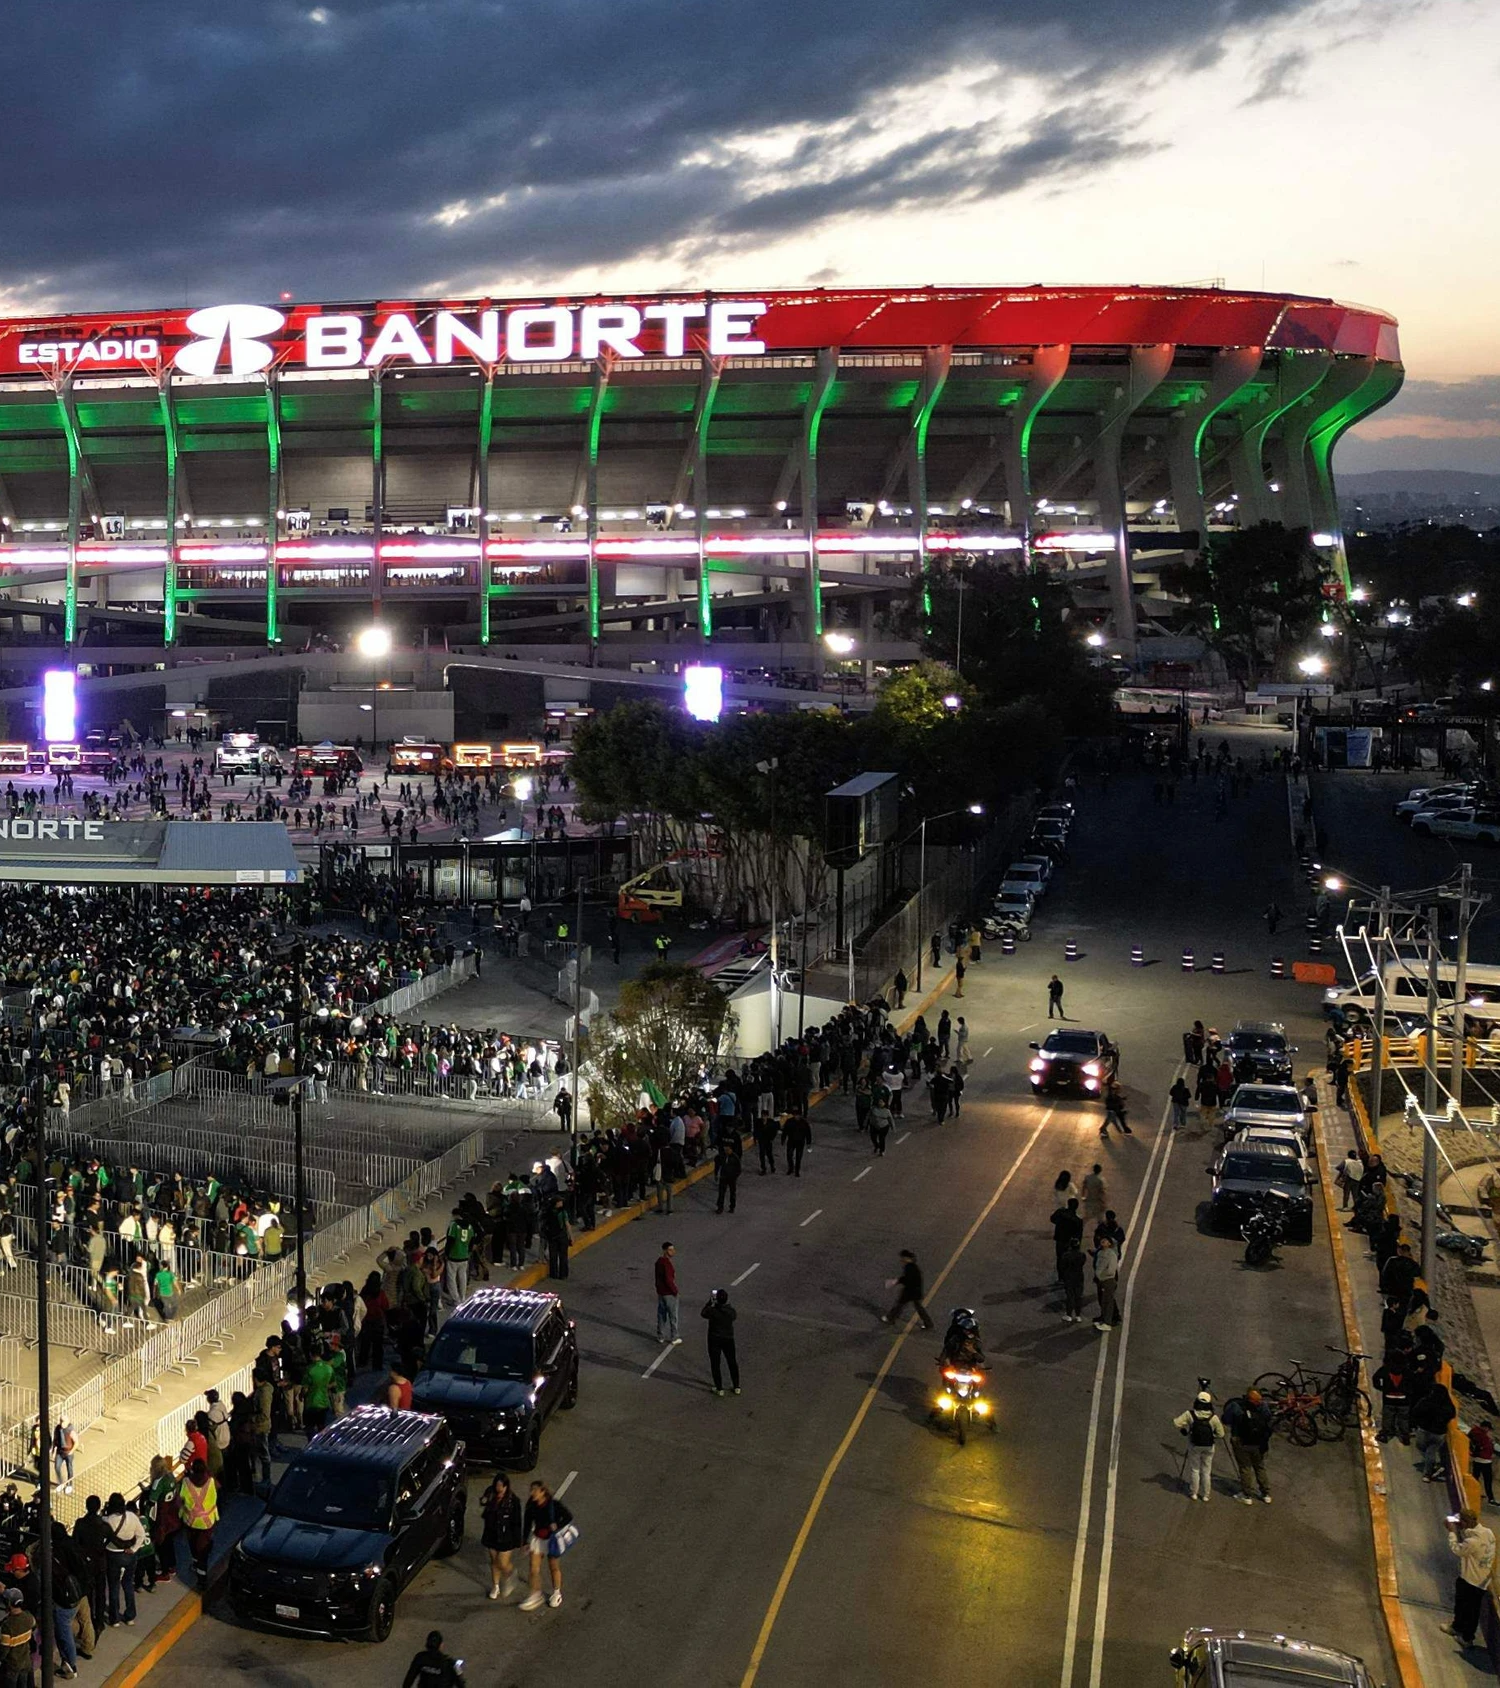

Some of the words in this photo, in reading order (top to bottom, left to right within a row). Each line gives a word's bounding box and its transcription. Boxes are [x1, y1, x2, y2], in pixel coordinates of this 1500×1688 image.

[18, 339, 158, 364] ESTADIO
[305, 302, 767, 367] BANORTE
[460, 1229, 468, 1242] 9
